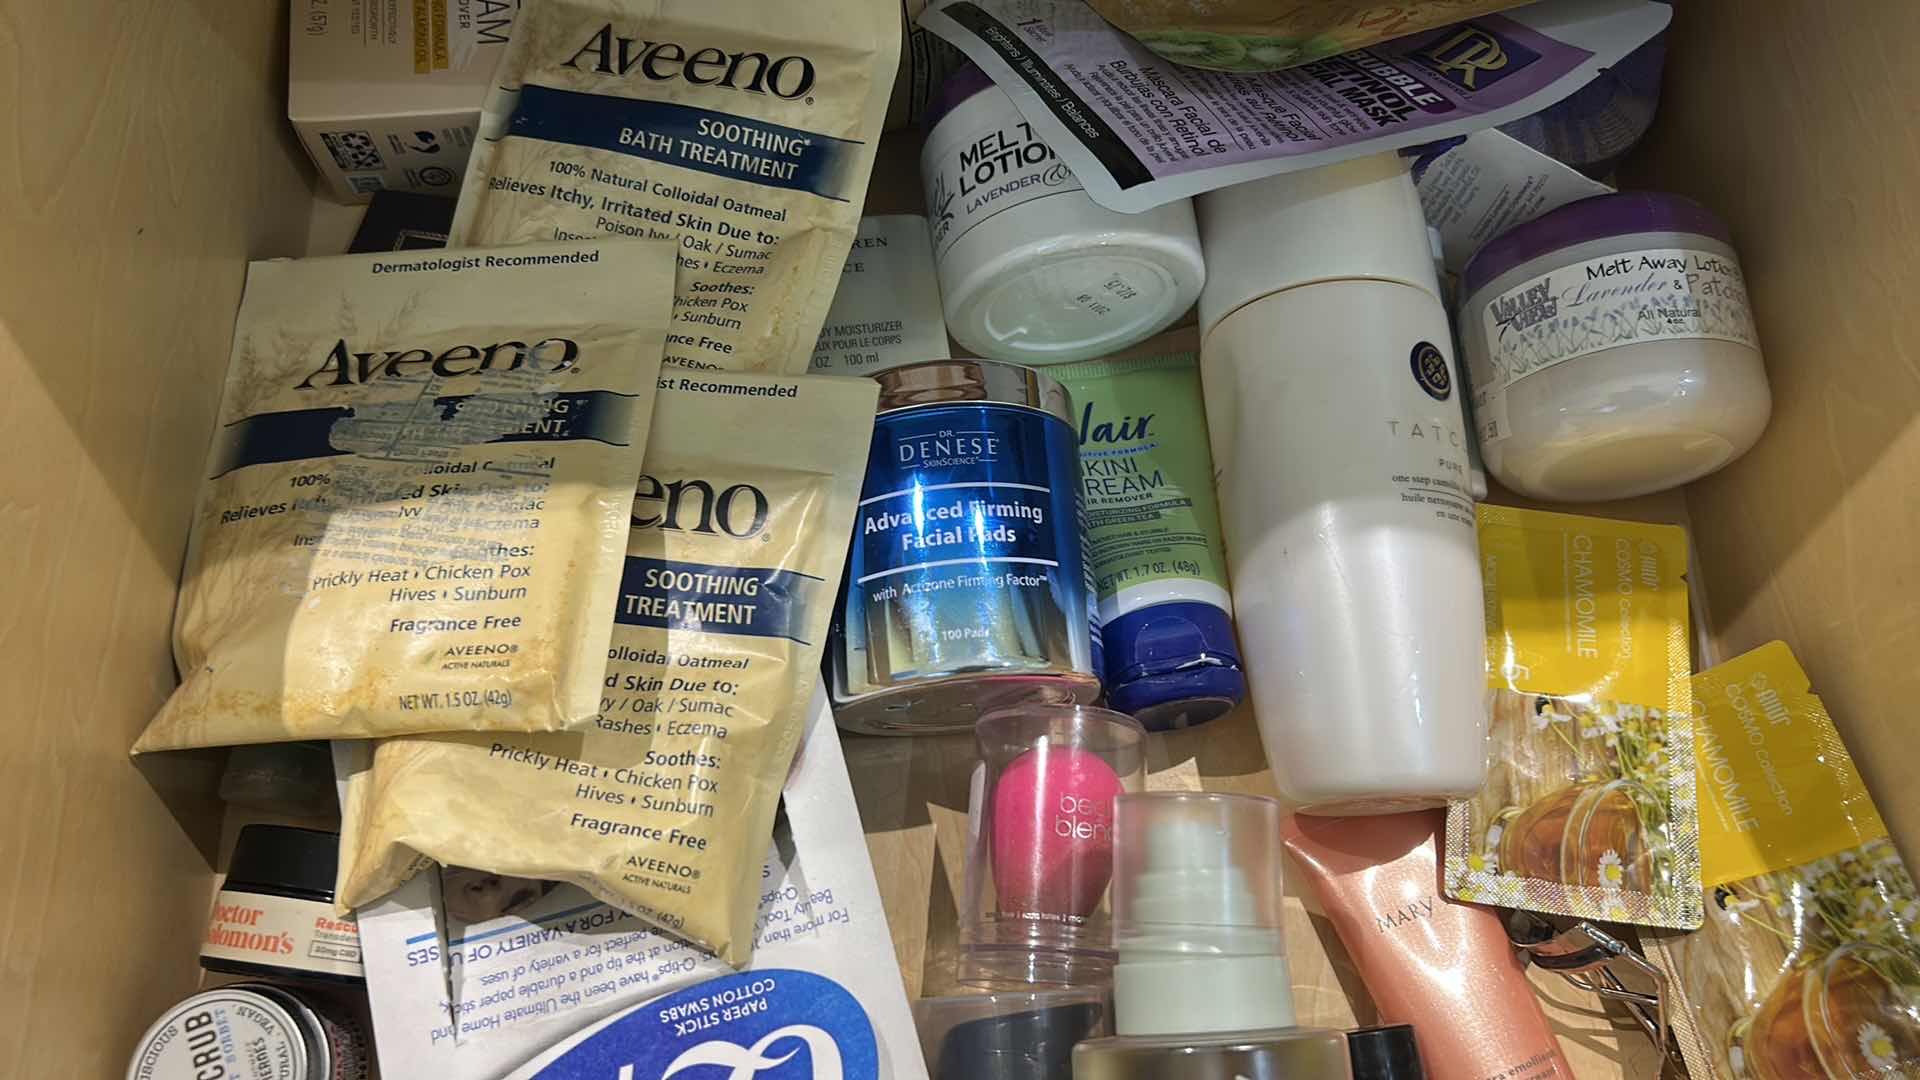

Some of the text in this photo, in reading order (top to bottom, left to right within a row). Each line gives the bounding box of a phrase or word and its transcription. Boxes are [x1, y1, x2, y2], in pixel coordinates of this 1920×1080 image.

[1324, 58, 1410, 122] ETINOL
[1108, 58, 1211, 158] Burbujas con Retinol
[1342, 84, 1402, 128] MASK
[1061, 101, 1099, 140] Balances
[1177, 105, 1228, 158] Facial de
[697, 118, 803, 155] SOOTHING
[619, 128, 799, 180] BATH TREATMENT
[549, 161, 786, 223] 100% Natural Colloidal Oatmeal
[966, 173, 1041, 215] LAVENDER
[488, 176, 780, 246] Relieves Itchy, Irritated Skin Due to:
[596, 217, 643, 239] Poison
[683, 234, 711, 252] Oak
[727, 244, 770, 261] Sumac
[372, 250, 599, 274] Dermatologist Recommended
[713, 262, 765, 276] Eczema
[1585, 255, 1741, 281] Melt Away Lotio
[690, 281, 755, 295] Soothes:
[1560, 272, 1682, 309] Lavender &
[721, 298, 749, 312] Pox
[1638, 309, 1654, 321] All
[682, 311, 742, 330] Sunburn
[834, 320, 903, 337] MOISTURIZER
[699, 336, 733, 354] Free
[872, 334, 902, 347] CORPS
[844, 351, 879, 366] 100 ml
[679, 378, 798, 398] Recommended
[939, 430, 955, 438] DR.
[1386, 420, 1460, 449] TATC
[900, 437, 999, 463] DENESE
[1084, 457, 1137, 476] KINI
[289, 472, 331, 488] 100%
[1085, 470, 1164, 495] REAM
[1102, 493, 1152, 504] REMOVER
[220, 500, 287, 525] Relieves
[864, 501, 1043, 534] Advaced Firming
[902, 526, 1017, 550] Facial Pads
[367, 568, 408, 584] Heat
[425, 564, 493, 582] Chicken
[500, 563, 531, 579] Pox
[1133, 559, 1200, 578] 1.7 (48g)
[1615, 537, 1633, 597] COSMO
[390, 585, 527, 603] Hives Sunburn
[644, 568, 758, 597] SOOTHING
[873, 574, 1004, 602] with Firming
[1572, 535, 1600, 659] CHAMOMILE
[625, 594, 757, 626] TREATMENT
[390, 615, 521, 635] Fragrance Free
[942, 630, 962, 640] 100
[441, 659, 511, 670] ACTIVE NATURALS
[608, 646, 749, 670] olloidal Oatmeal
[624, 675, 664, 692] Skin
[669, 678, 706, 692] Due
[712, 679, 739, 696] to:
[399, 688, 512, 711] NET WT. 1.5 (42g)
[632, 699, 662, 714] Oak
[679, 698, 734, 717] Sumac
[1725, 682, 1765, 747] COSMO
[667, 721, 727, 739] Eczema
[489, 743, 719, 793] Prickly Heat Chicken Pox
[644, 750, 720, 769] Soothes:
[576, 784, 714, 818] Hives Sunburn
[570, 813, 707, 850] Fragrance Free
[1056, 814, 1108, 840] blen
[622, 874, 691, 894] ACTIVE NATURALS
[213, 902, 264, 928] octor
[315, 916, 359, 933] Rescu
[577, 908, 615, 931] FOR
[1376, 896, 1434, 934] MARY
[476, 886, 834, 1009] Beauty the tip durable paper
[495, 924, 563, 955] VARIETY
[407, 946, 463, 969] USES
[464, 943, 493, 963] OF
[527, 927, 649, 978] perfect for variety
[460, 906, 849, 1036] For more than have been the Ultimate Home
[657, 976, 777, 1023] COTTON SWABS
[672, 996, 768, 1036] PAPER STICK
[184, 1010, 226, 1080] CRUB
